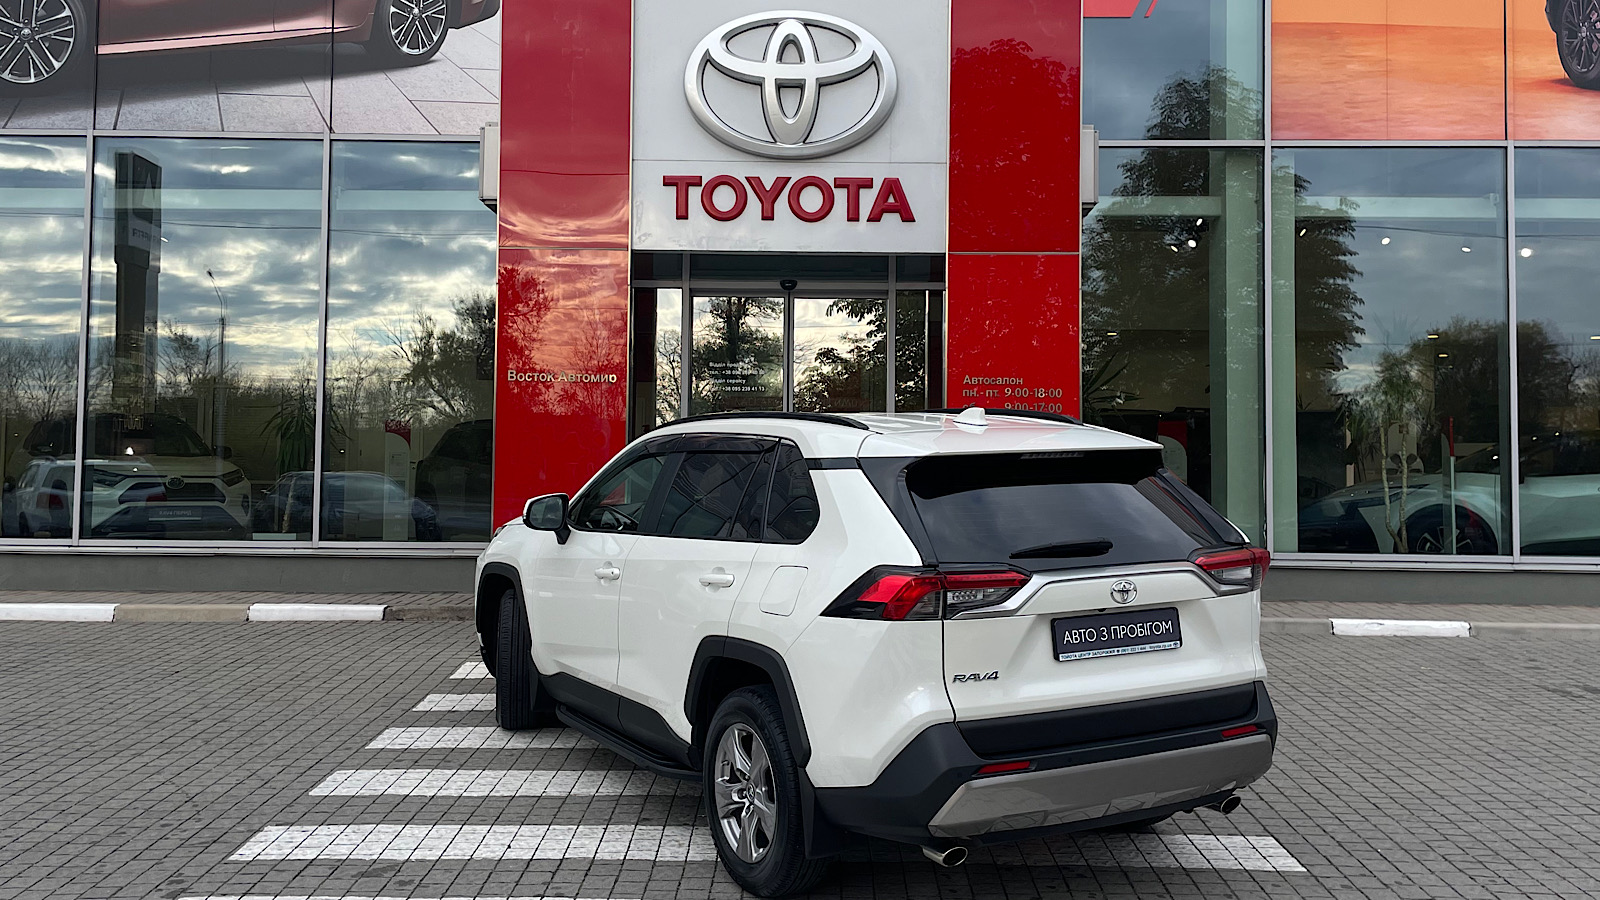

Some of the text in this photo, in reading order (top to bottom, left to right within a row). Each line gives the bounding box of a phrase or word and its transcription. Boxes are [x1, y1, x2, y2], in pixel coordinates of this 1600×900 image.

[662, 174, 917, 223] TOYOTA
[507, 369, 617, 386] Восток Автомир
[963, 374, 1024, 385] Автосалон
[1063, 627, 1097, 645] АВТО
[1110, 620, 1173, 640] ПРОБІГОМ
[951, 669, 1000, 683] RAV4
